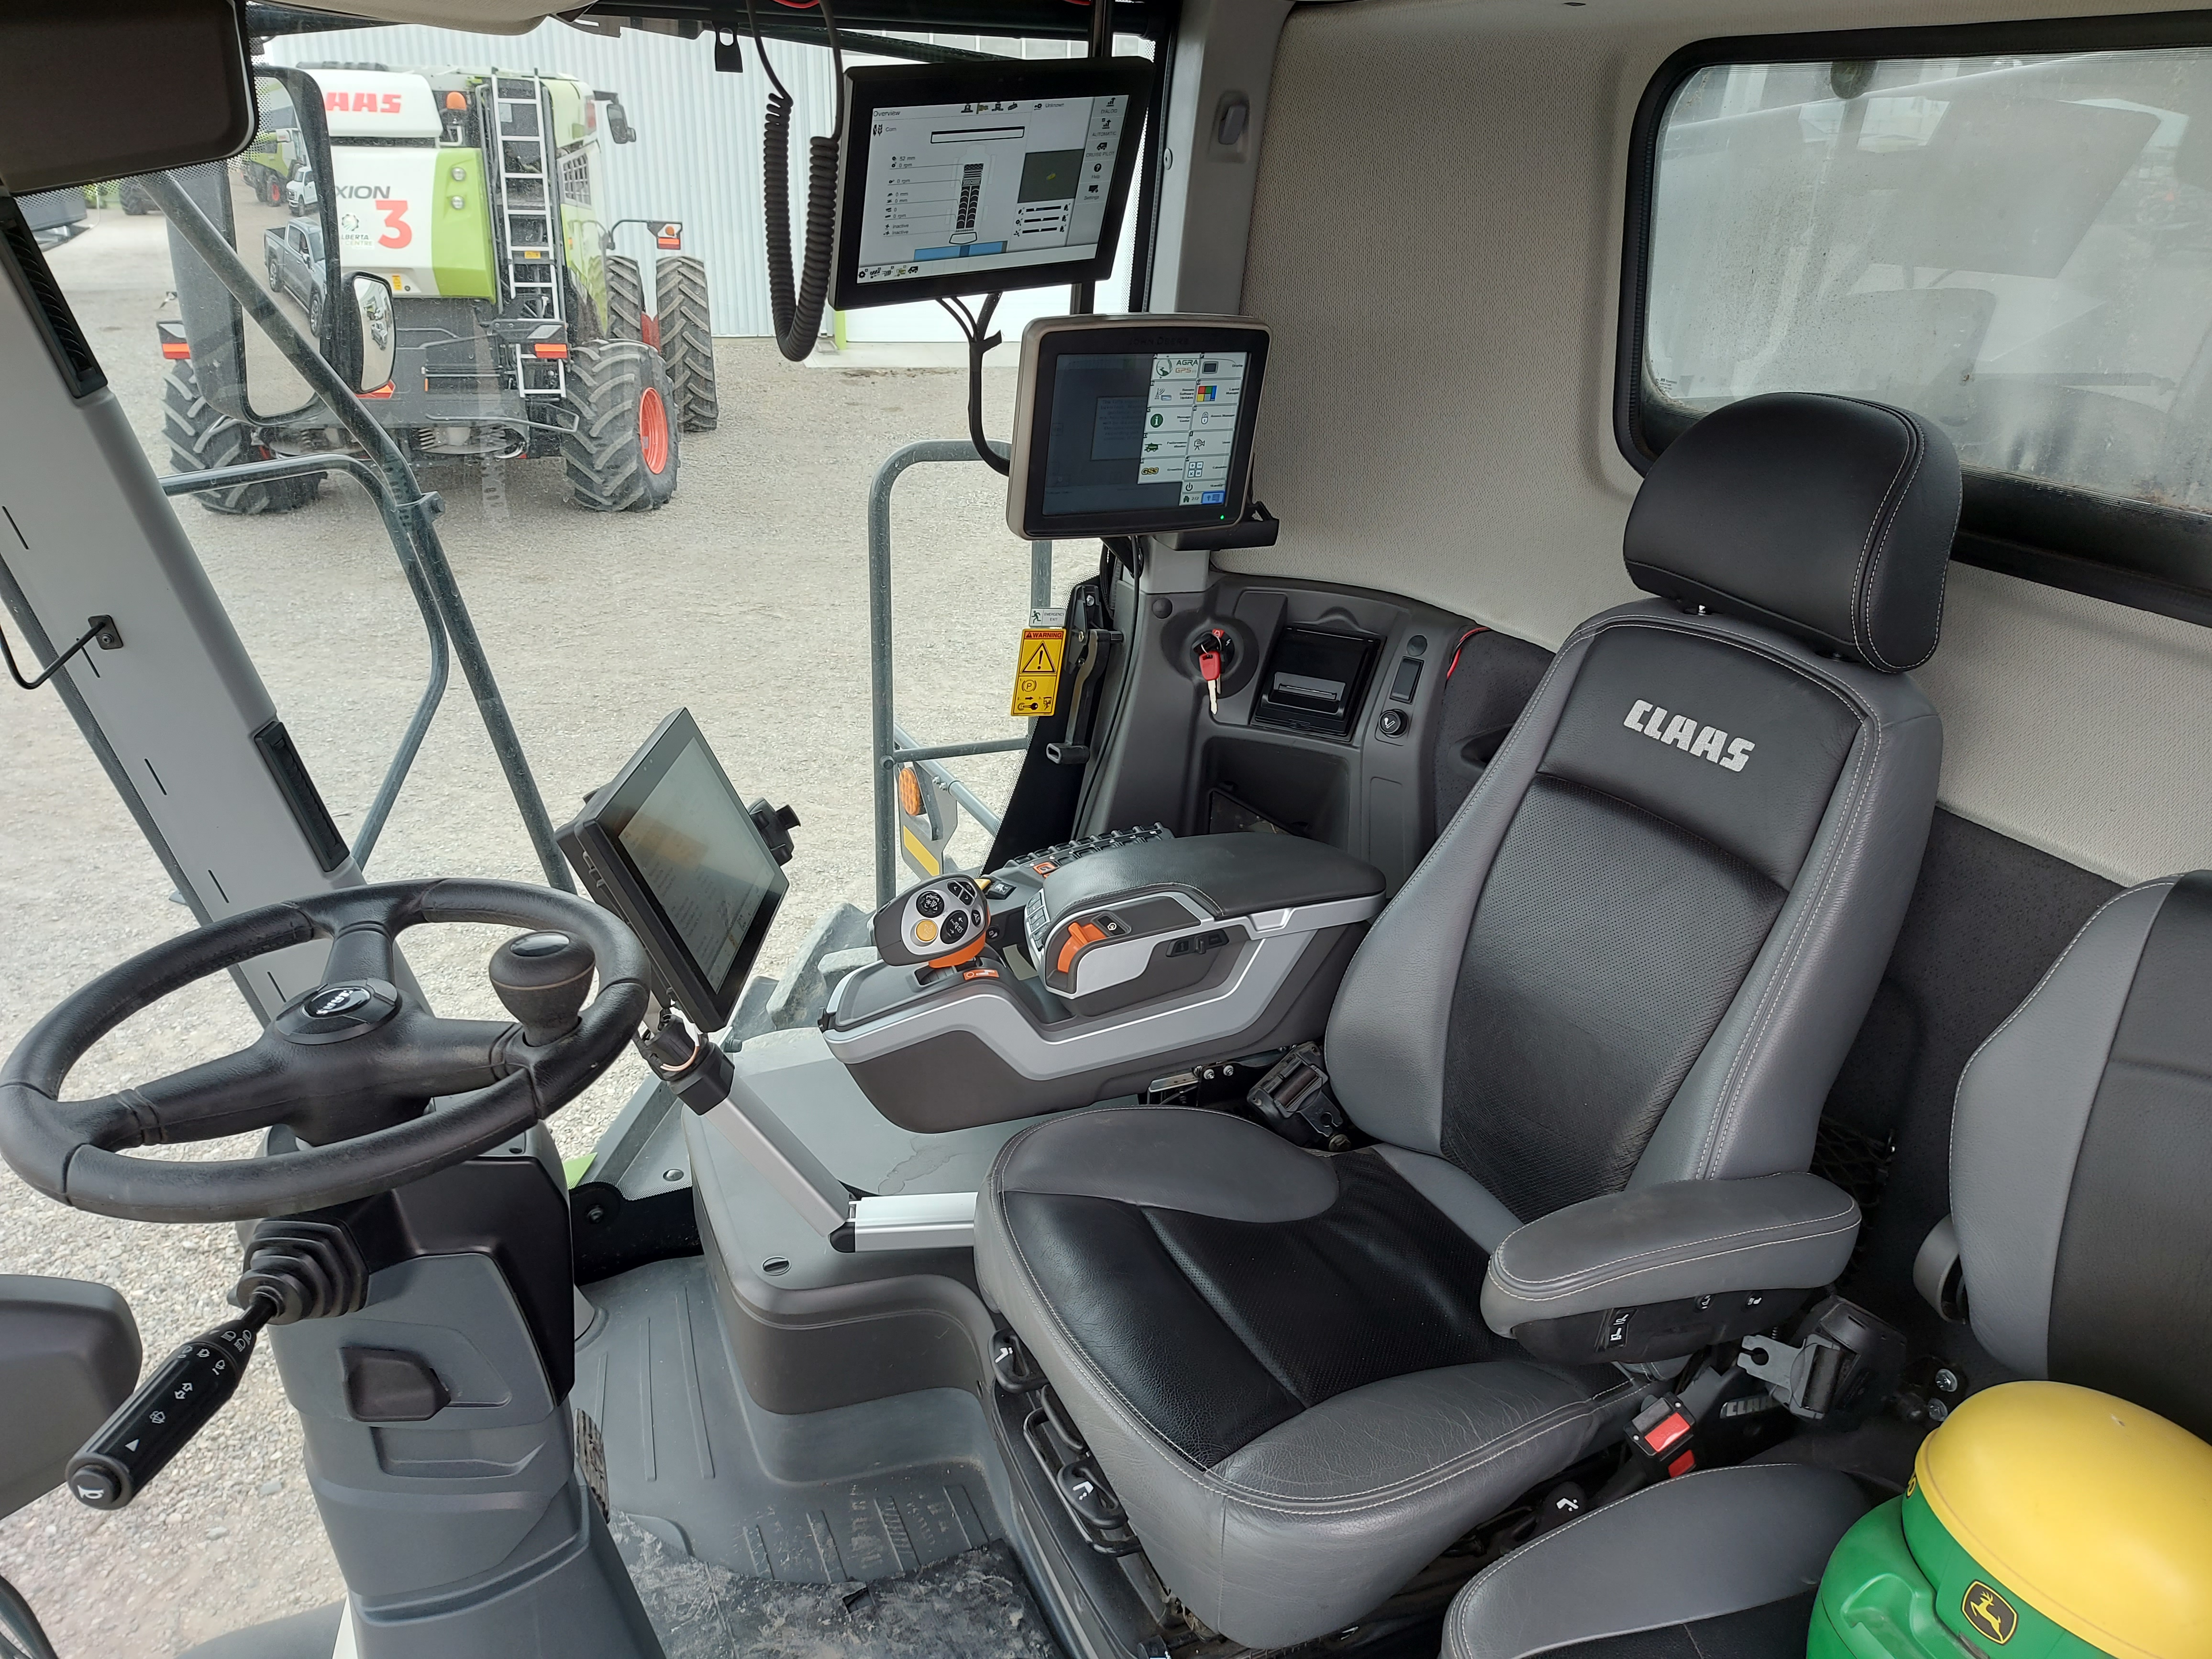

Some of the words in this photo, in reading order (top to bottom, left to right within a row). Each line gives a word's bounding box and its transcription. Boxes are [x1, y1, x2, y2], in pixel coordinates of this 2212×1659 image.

[326, 92, 401, 113] AAS
[335, 186, 390, 199] XION
[375, 200, 412, 249] 3
[1624, 699, 1755, 772] CLAAS
[1726, 1396, 1774, 1416] CLAA
